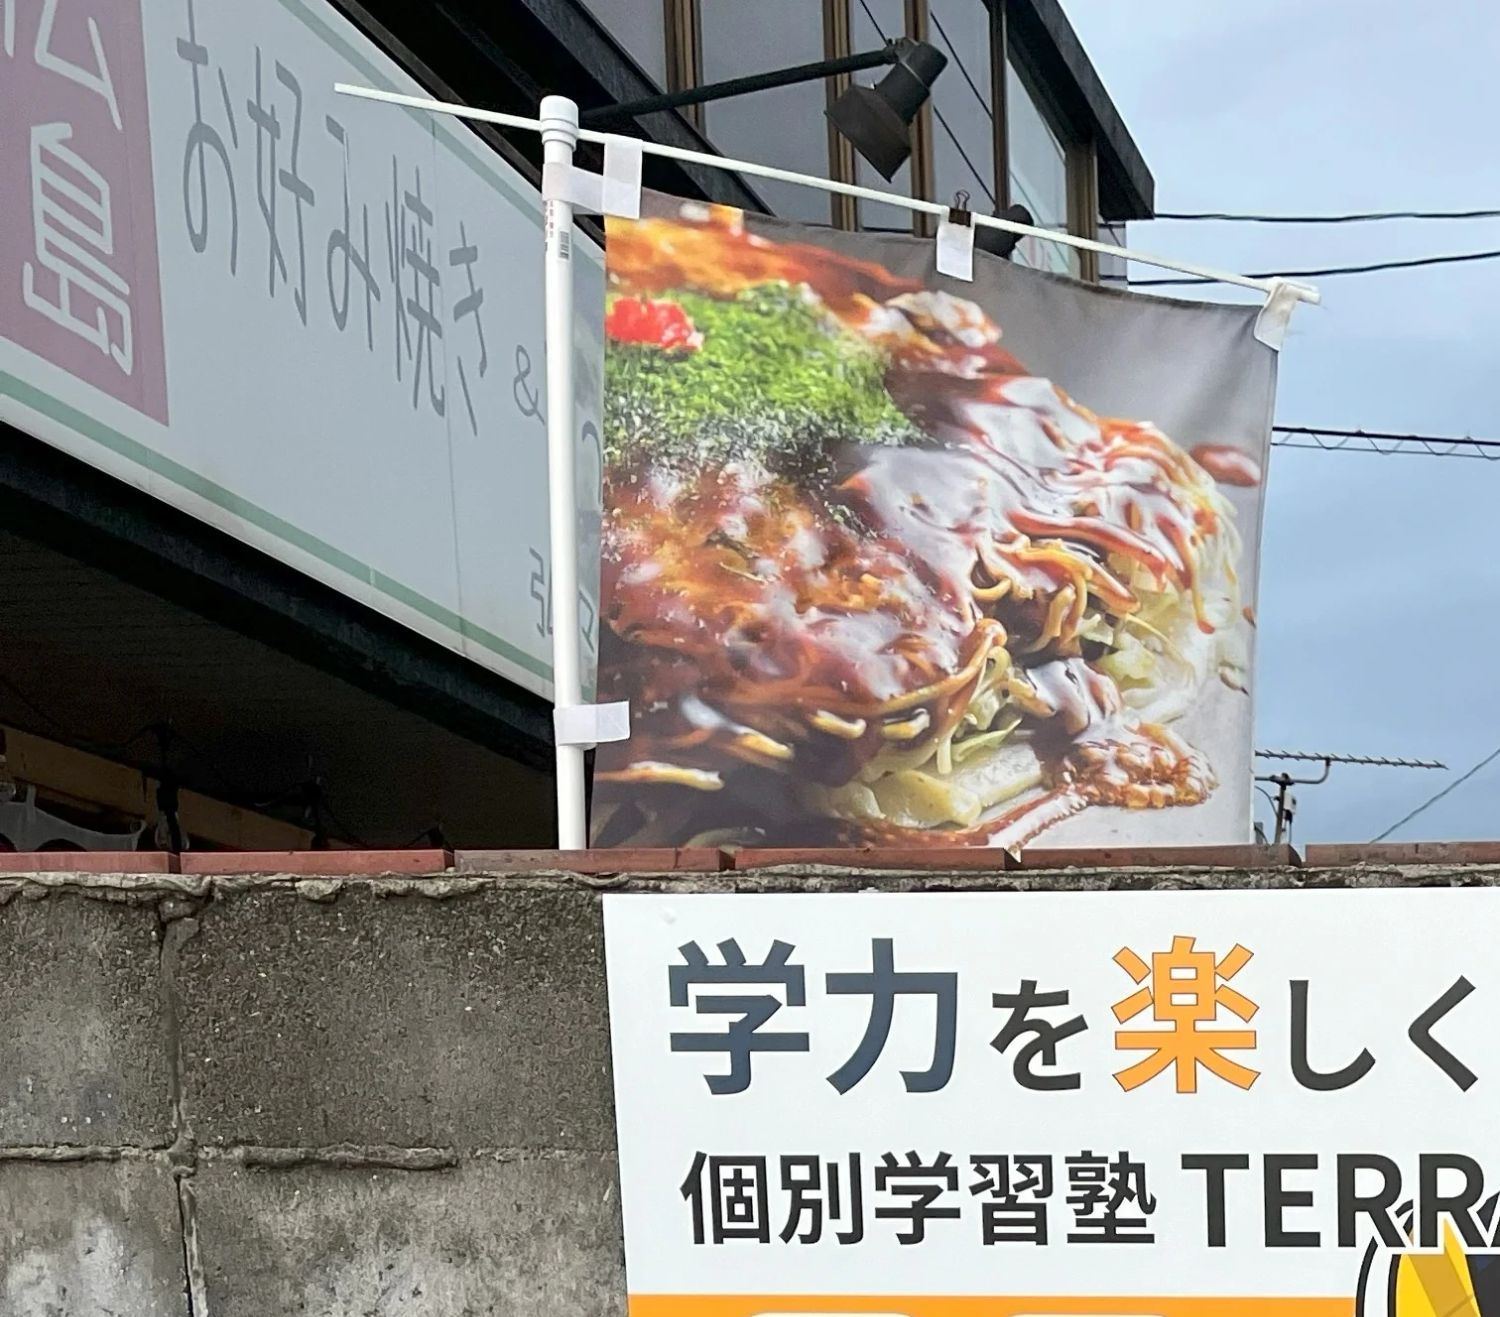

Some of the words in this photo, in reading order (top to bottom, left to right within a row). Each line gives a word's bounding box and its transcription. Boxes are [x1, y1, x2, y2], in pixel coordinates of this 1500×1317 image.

[680, 1149, 1156, 1246] 個別学習塾
